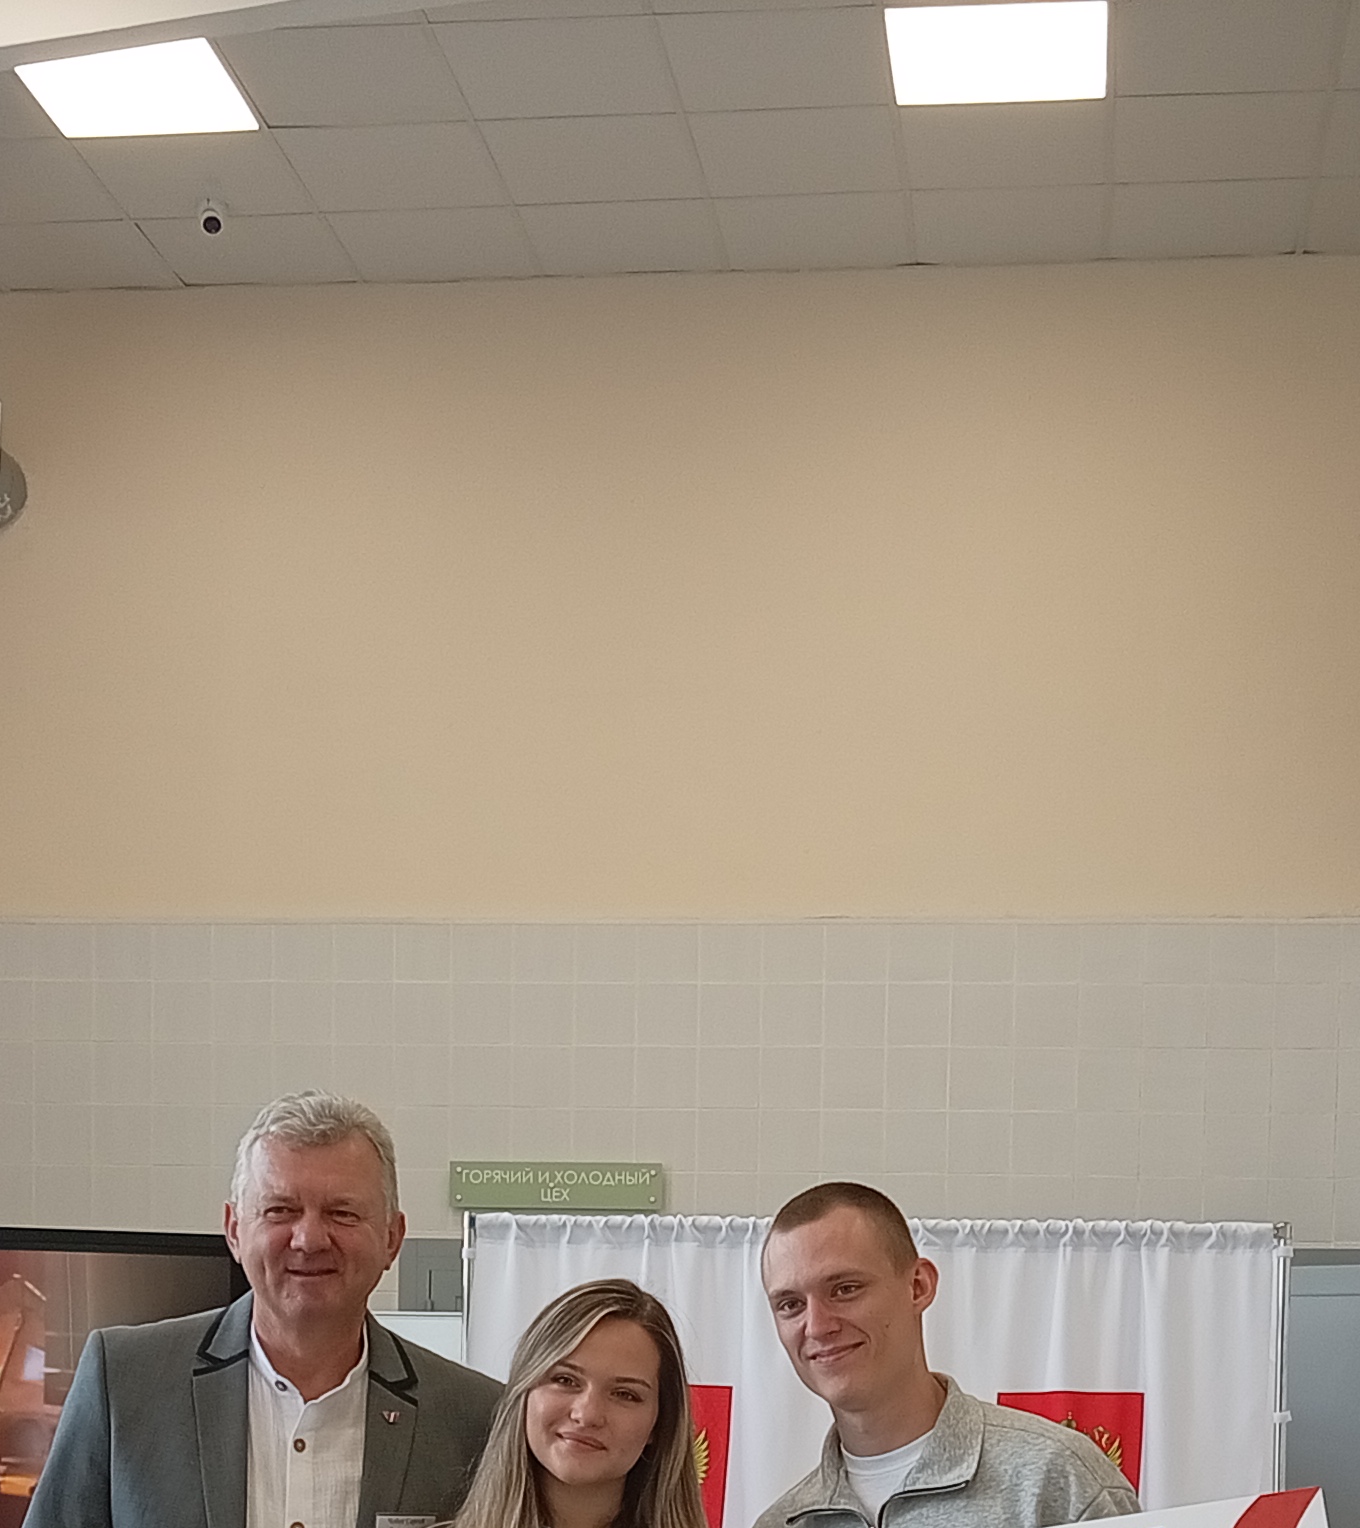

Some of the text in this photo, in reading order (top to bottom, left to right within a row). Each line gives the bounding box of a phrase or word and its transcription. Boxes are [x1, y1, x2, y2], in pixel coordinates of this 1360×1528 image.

[462, 1168, 650, 1185] ГОРЯЧИЙ И ХОЛОДНЫЙ
[541, 1188, 570, 1202] ЦЕХ
